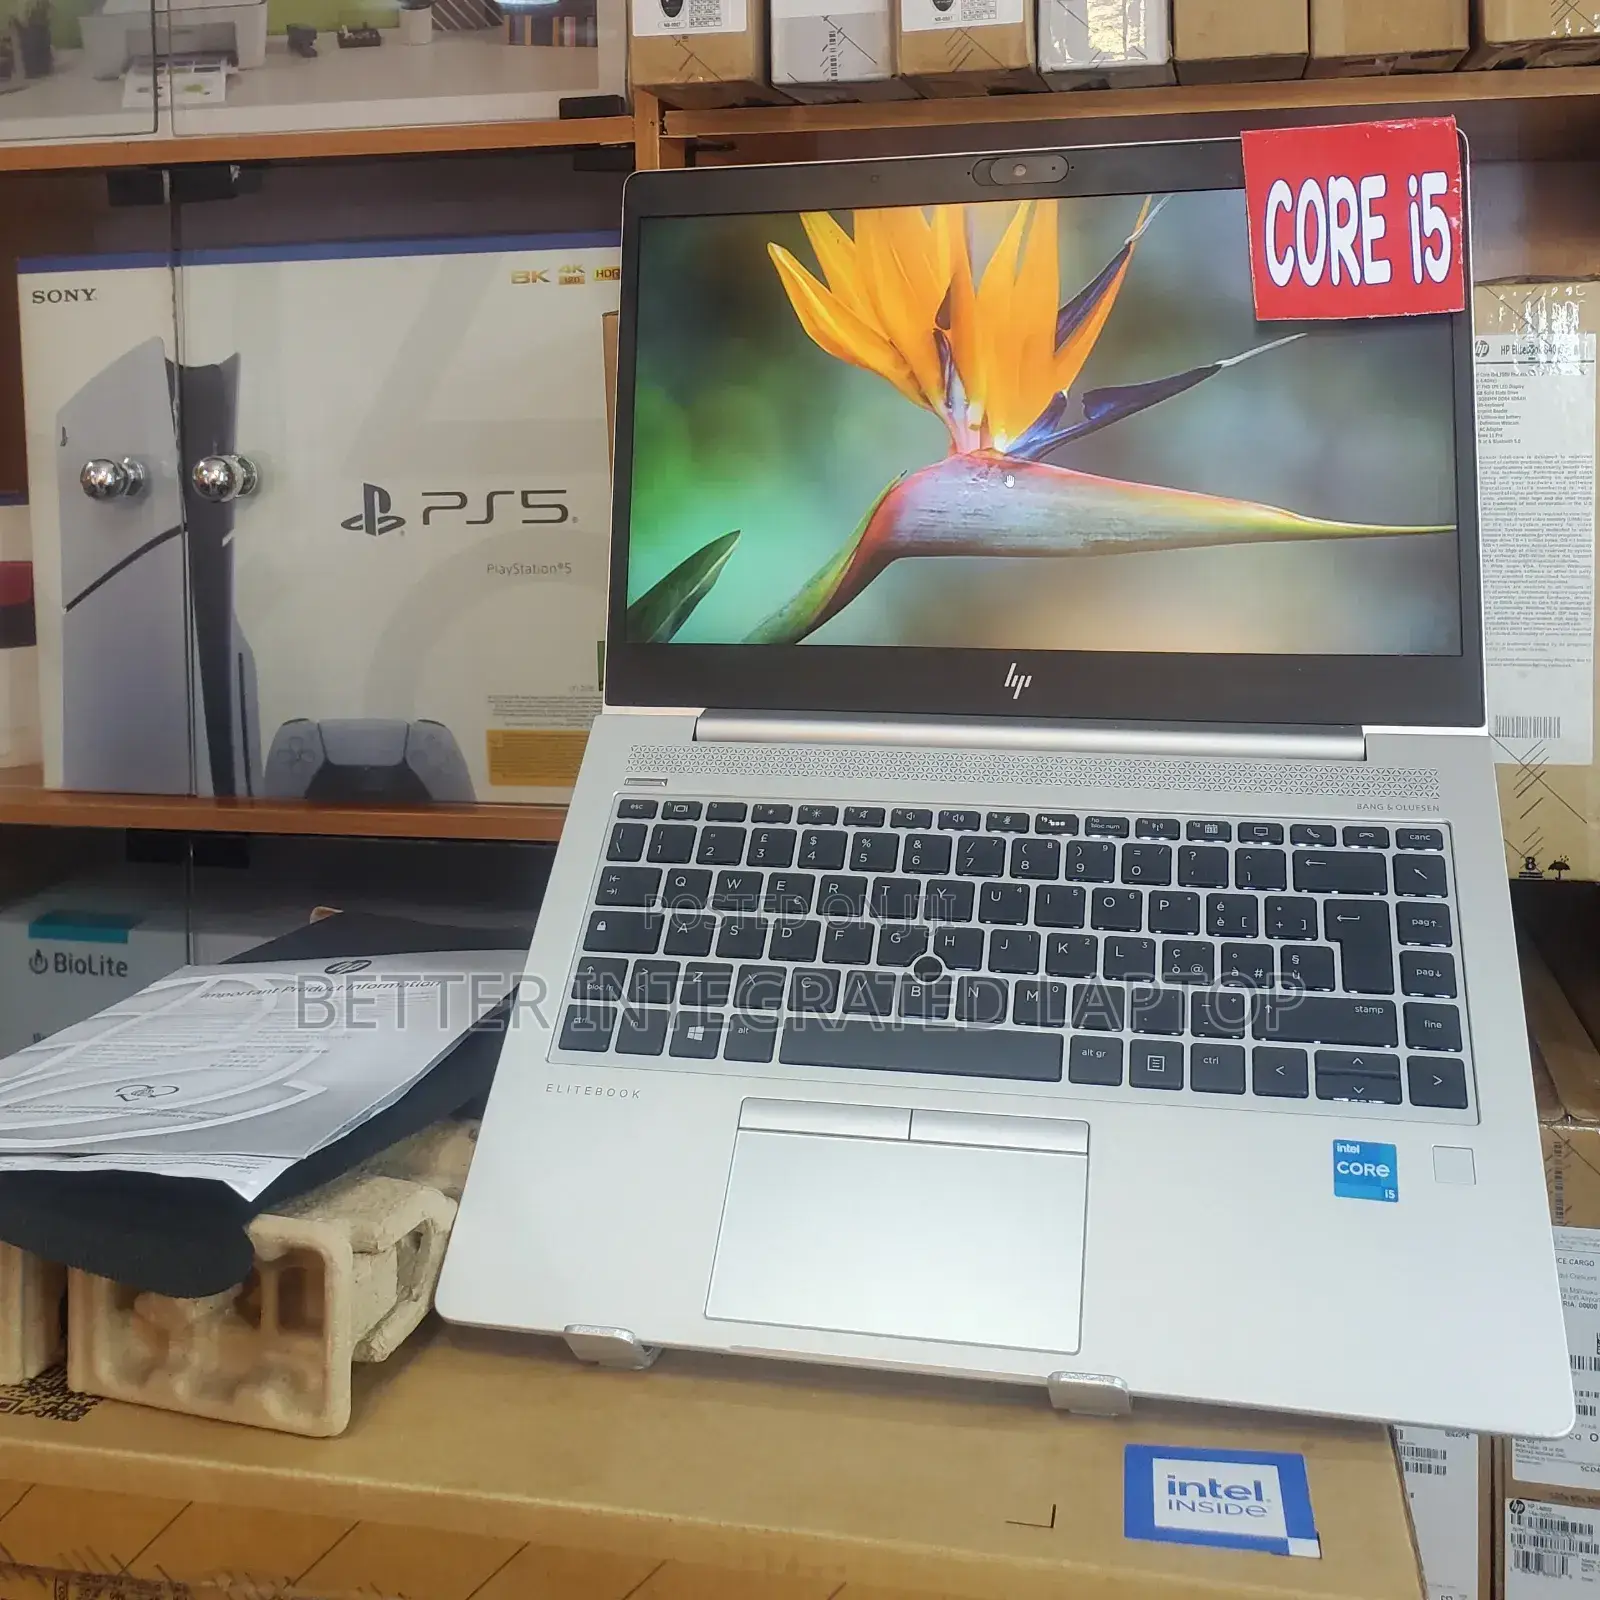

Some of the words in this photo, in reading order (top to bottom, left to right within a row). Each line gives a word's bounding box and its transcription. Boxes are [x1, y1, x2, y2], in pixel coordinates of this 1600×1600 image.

[1265, 173, 1392, 287] CORE
[1408, 170, 1452, 284] i5
[511, 268, 551, 284] 8K
[32, 288, 96, 304] SONY
[1500, 345, 1510, 355] HP
[422, 490, 569, 526] PS5
[1356, 803, 1384, 811] BANG
[1395, 804, 1440, 812] OLUFSEN
[706, 847, 715, 856] 2
[756, 848, 764, 858] 3
[807, 851, 816, 860] 4
[860, 854, 868, 862] 5
[912, 856, 920, 864] 6
[966, 858, 974, 867] 7
[1021, 861, 1030, 870] 8
[1076, 863, 1085, 873] 9
[676, 876, 687, 886] Q
[726, 878, 742, 888] W
[777, 881, 786, 891] E
[828, 884, 839, 893] R
[882, 886, 891, 896] T
[937, 888, 947, 898] Y
[991, 892, 1002, 901] U
[1159, 900, 1169, 910] P
[677, 922, 688, 934] A
[729, 925, 738, 935] S
[782, 928, 792, 938] D
[835, 931, 844, 941] F
[890, 933, 901, 944] G
[945, 936, 955, 946] H
[1000, 939, 1009, 950] J
[1058, 943, 1069, 954] K
[1116, 946, 1124, 957] L
[54, 952, 128, 978] BioLite
[692, 972, 704, 982] Z
[746, 974, 758, 985] X
[279, 984, 344, 994] Product
[346, 980, 442, 992] Information
[801, 977, 812, 988] C
[857, 980, 868, 991] V
[911, 986, 921, 997] B
[968, 987, 979, 998] N
[1026, 990, 1039, 1002] M
[1355, 1005, 1384, 1014] stamp
[1424, 1020, 1442, 1029] fine
[738, 1026, 749, 1034] alt
[1082, 1049, 1094, 1057] alt
[1096, 1050, 1106, 1058] gr
[1203, 1056, 1219, 1065] ctrl
[546, 1083, 642, 1100] ELITEBOOK
[1336, 1143, 1360, 1154] intel
[1385, 1189, 1395, 1199] i5
[1569, 1259, 1594, 1267] CARGO
[1167, 1474, 1264, 1502] intel
